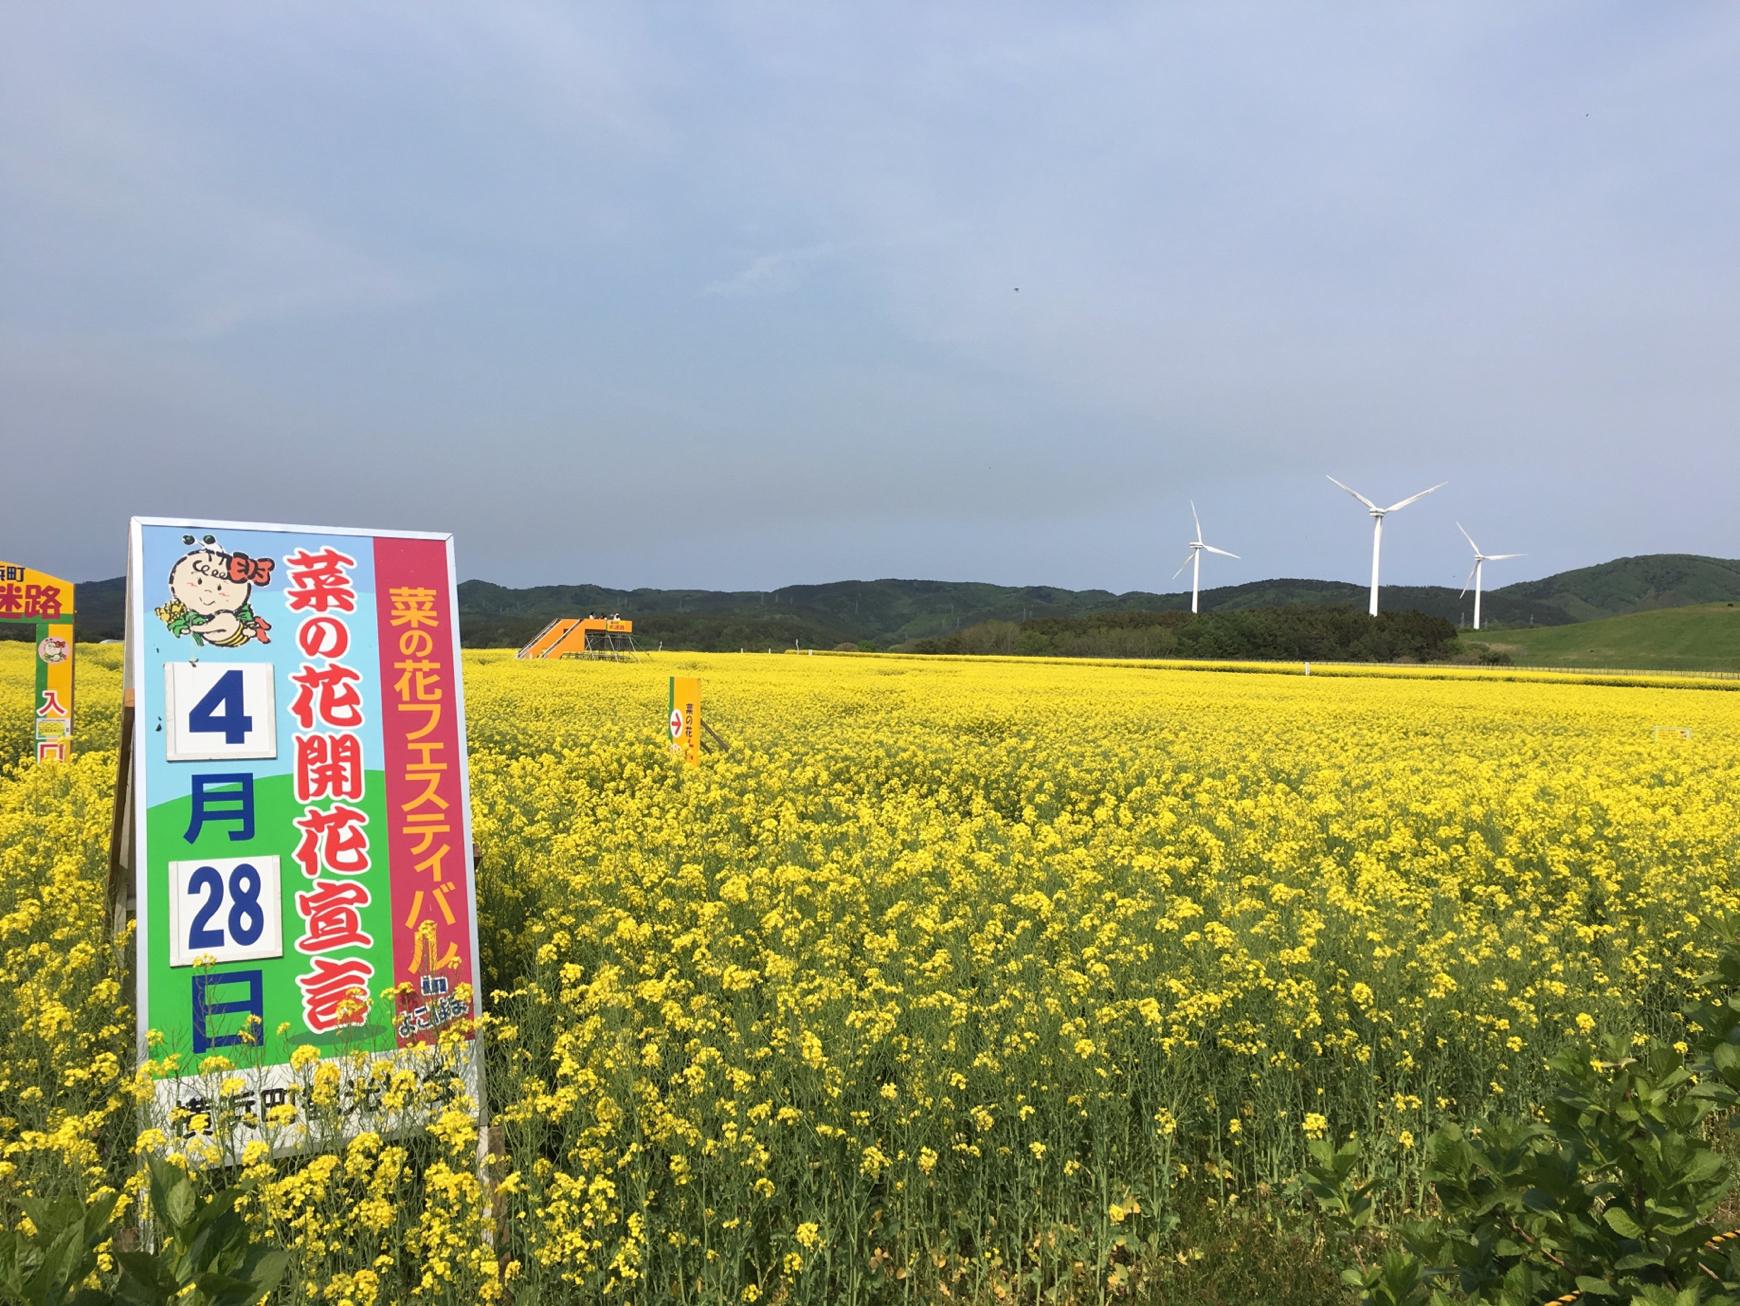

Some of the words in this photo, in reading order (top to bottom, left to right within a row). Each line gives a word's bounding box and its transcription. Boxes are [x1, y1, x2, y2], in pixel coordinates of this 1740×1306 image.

[285, 547, 373, 1032] 菜の花開花宣言
[388, 586, 458, 974] 菜の花フェスティバル
